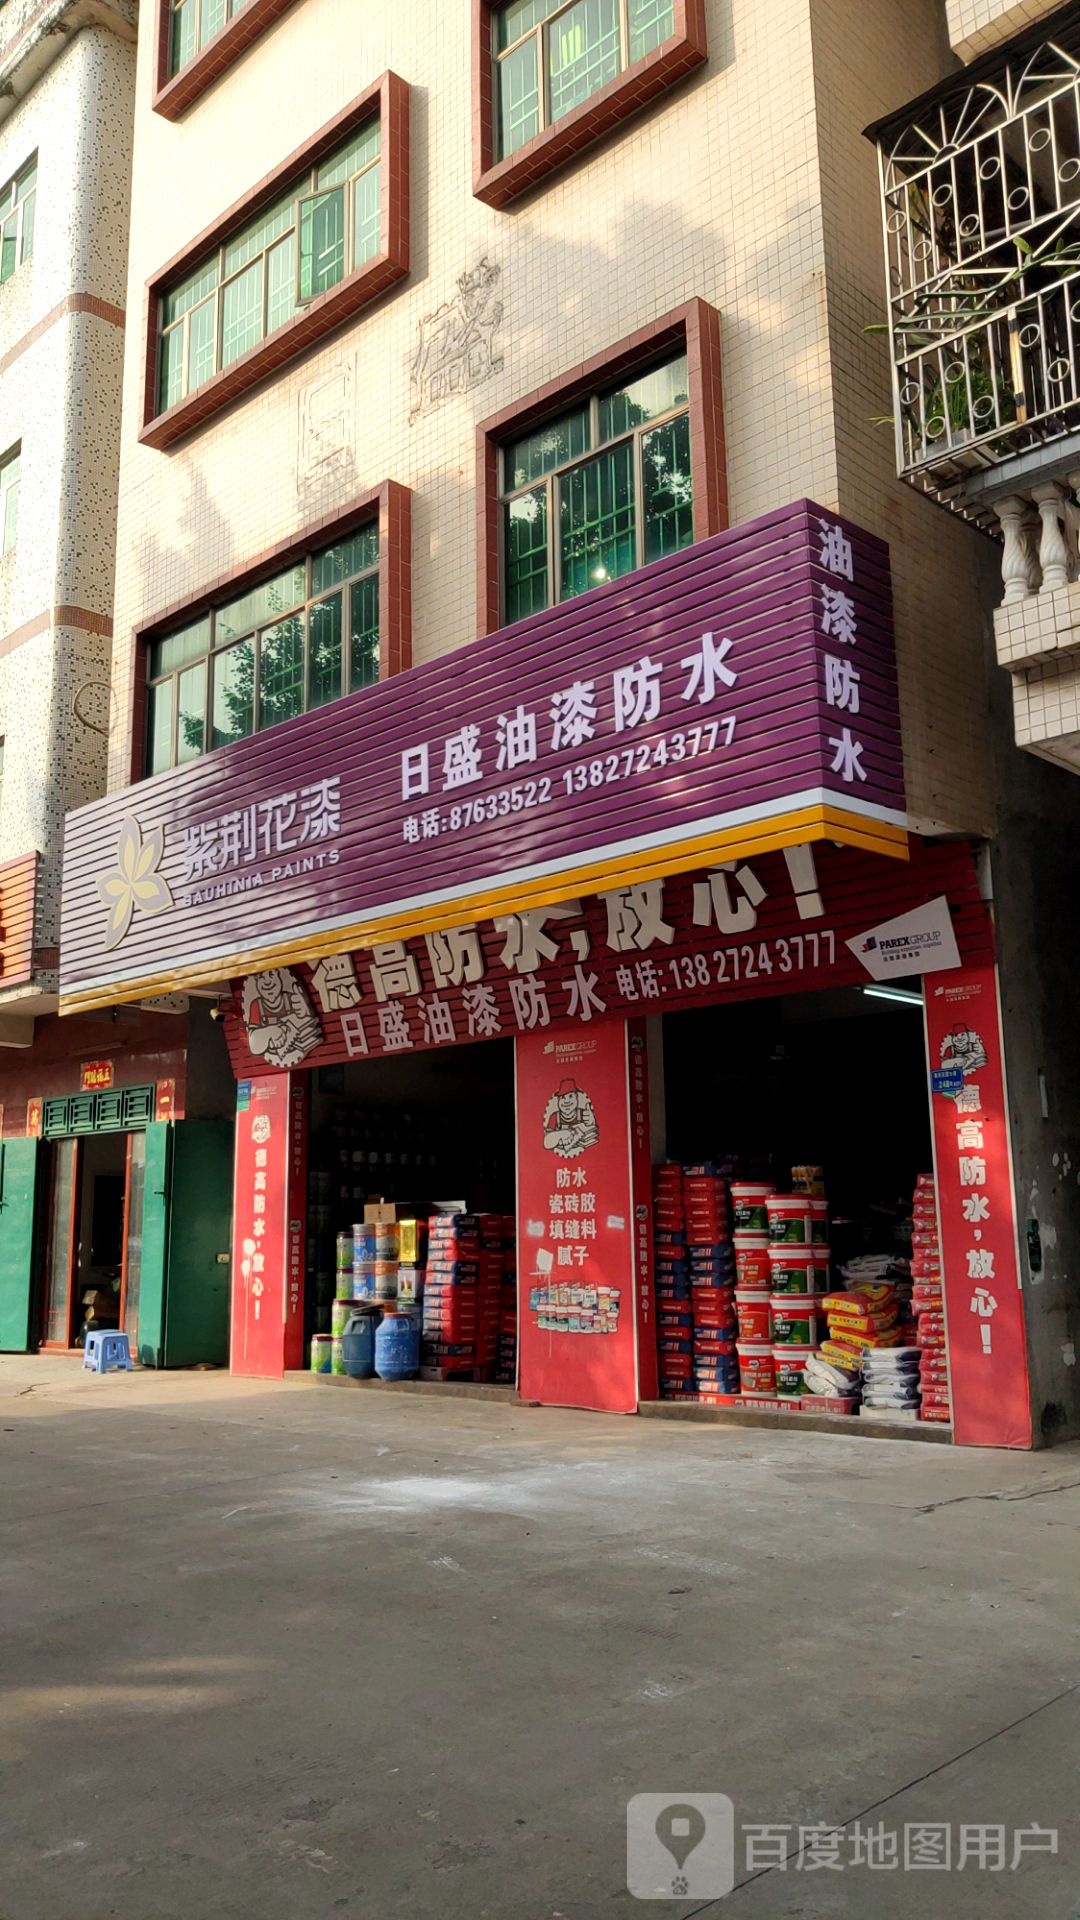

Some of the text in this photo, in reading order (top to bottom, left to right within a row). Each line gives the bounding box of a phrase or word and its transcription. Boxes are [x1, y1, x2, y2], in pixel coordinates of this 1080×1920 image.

[819, 518, 867, 782] 油漆防水
[401, 632, 738, 800] 日盛油漆防水
[562, 715, 736, 795] 13827243777
[183, 777, 341, 881] 紫荆花漆
[182, 848, 340, 906] BAUHINIA PAINTS
[340, 964, 606, 1056] 日盛油漆防水
[549, 1192, 596, 1213] 瓷砖胶
[556, 1167, 588, 1188] 防水
[549, 1218, 597, 1240] 填缝料
[557, 1245, 590, 1266] 腻子
